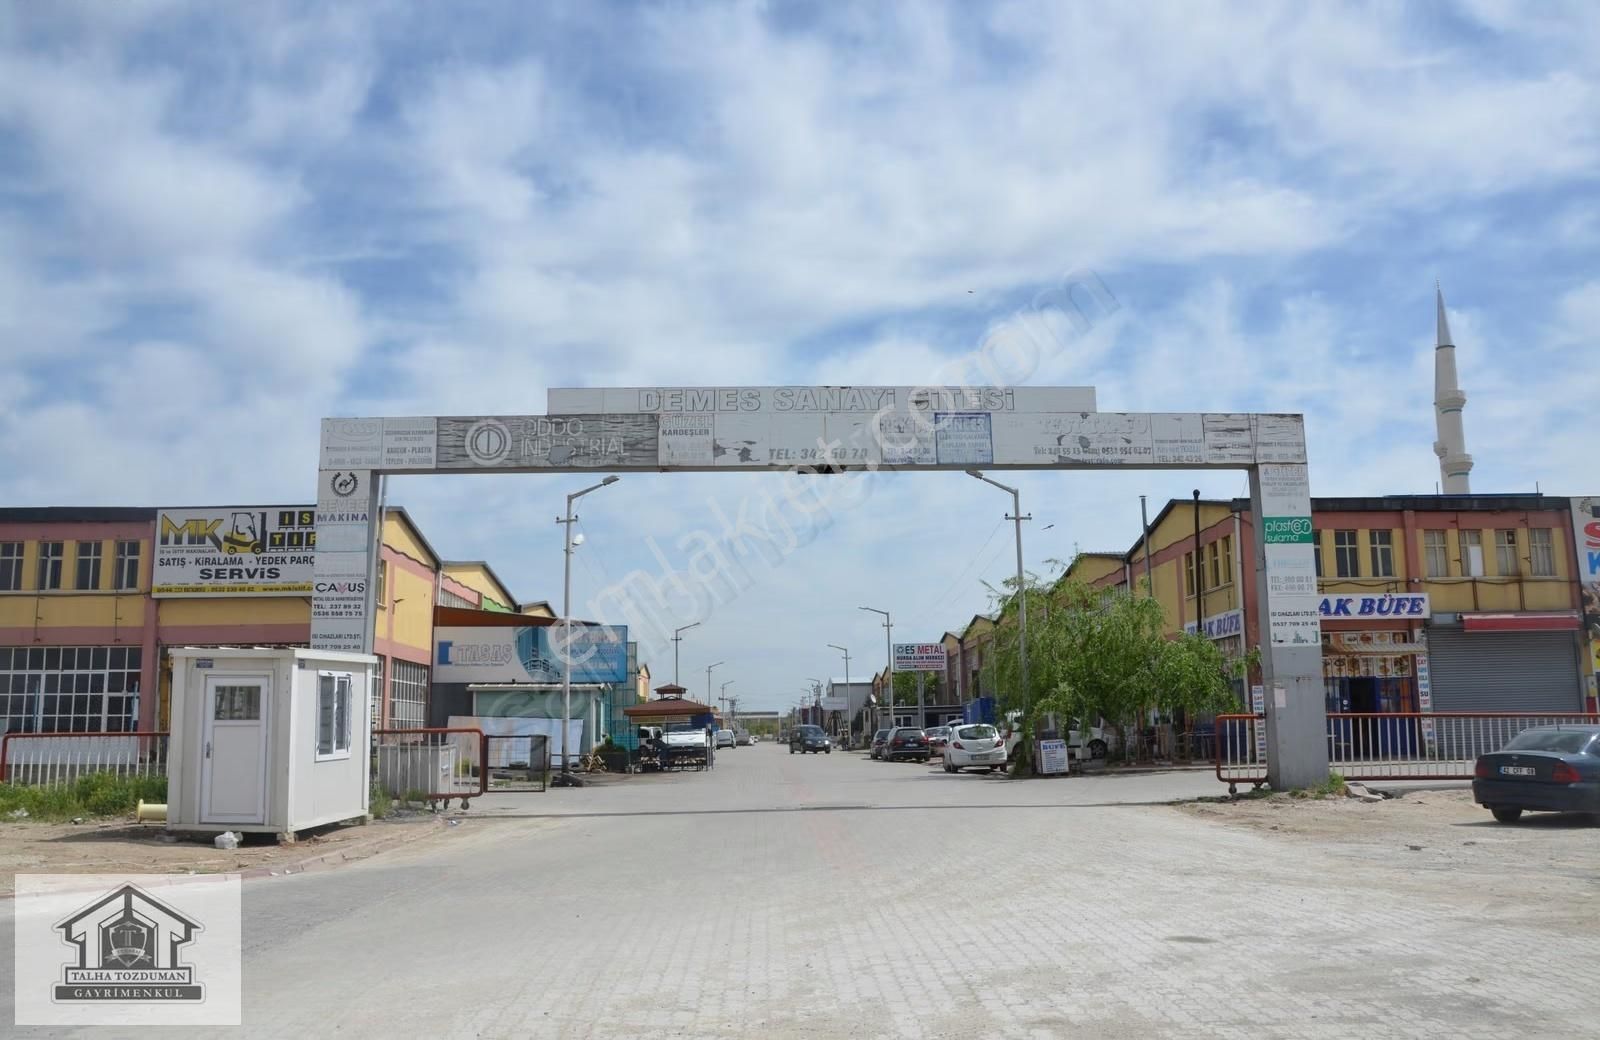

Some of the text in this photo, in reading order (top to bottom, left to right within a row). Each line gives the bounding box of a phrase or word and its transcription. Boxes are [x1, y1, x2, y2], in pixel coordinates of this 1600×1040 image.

[639, 389, 761, 412] DEMES
[662, 429, 709, 437] KARDEŞLER
[768, 448, 796, 460] TEL:
[160, 512, 225, 553] MK
[1267, 532, 1299, 541] sulama
[159, 557, 186, 568] SATIŞ
[256, 556, 286, 566] YEDEK
[1358, 593, 1425, 616] BÜFE
[905, 645, 945, 654] ES METAL
